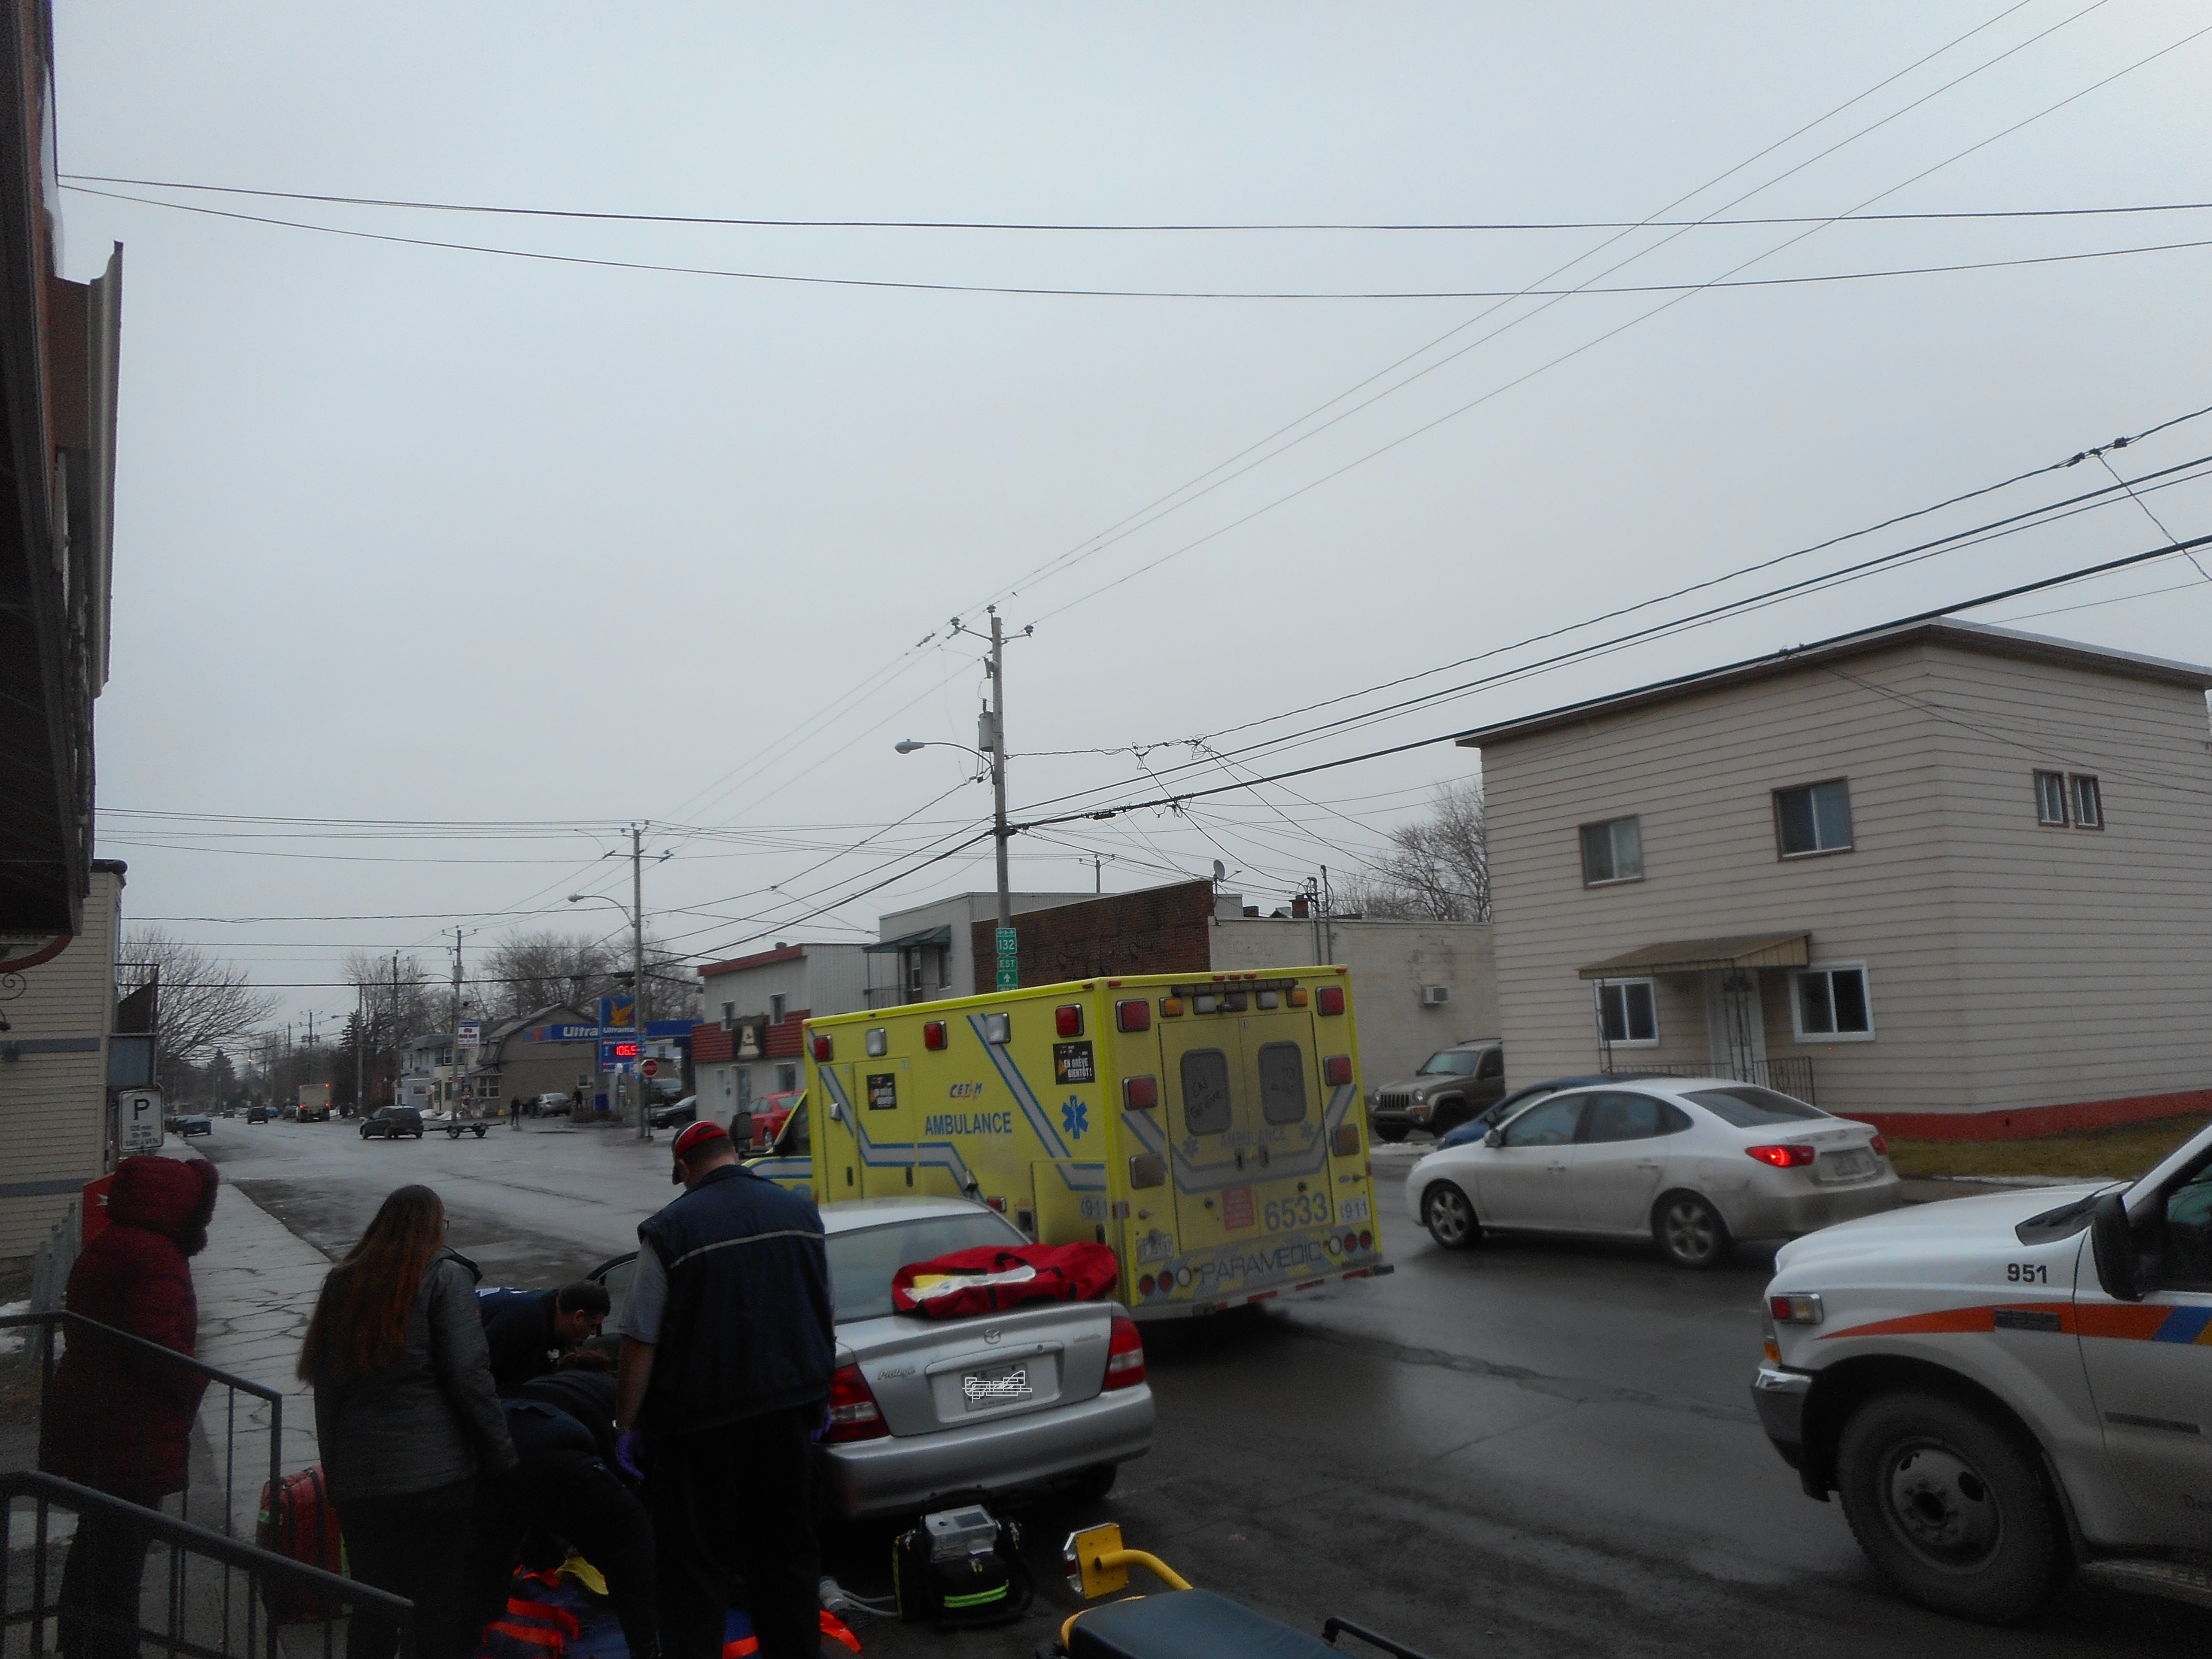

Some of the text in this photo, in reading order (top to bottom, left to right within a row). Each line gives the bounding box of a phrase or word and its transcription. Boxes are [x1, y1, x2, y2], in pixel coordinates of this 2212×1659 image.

[999, 939, 1015, 950] 132
[1000, 960, 1015, 968] EST
[134, 1099, 150, 1120] P
[925, 1112, 1012, 1135] AMBULANCE
[1221, 1125, 1286, 1149] AMBULANCE
[1264, 1192, 1328, 1231] 6533
[1200, 1240, 1322, 1284] PARAMEDIC
[2007, 1263, 2048, 1283] 951
